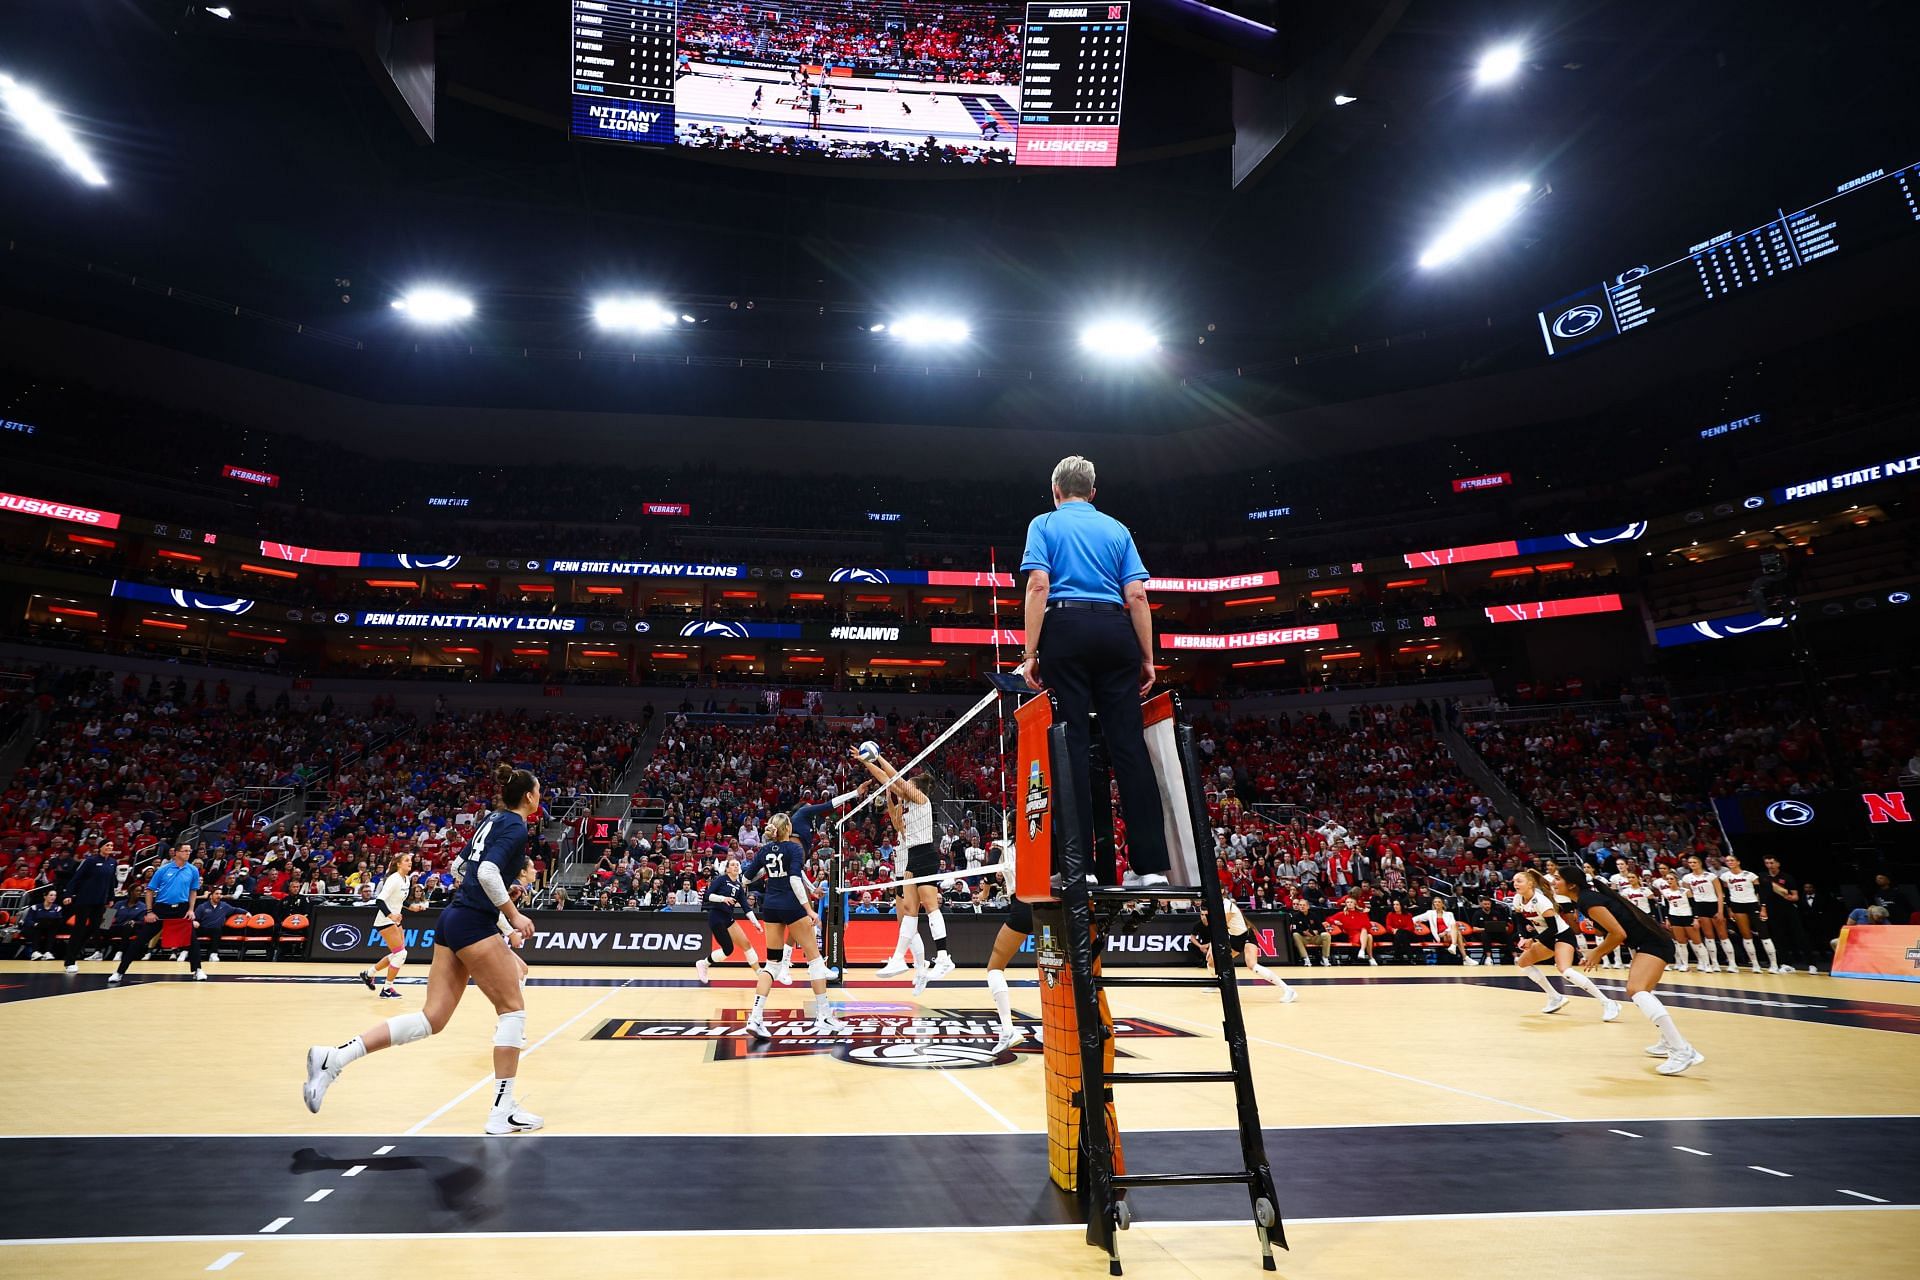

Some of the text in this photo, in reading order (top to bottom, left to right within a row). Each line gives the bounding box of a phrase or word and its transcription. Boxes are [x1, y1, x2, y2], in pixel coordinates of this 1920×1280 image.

[1048, 6, 1122, 19] NEBRASKA N
[590, 106, 660, 123] NITTANY
[600, 119, 650, 133] LIONS
[1027, 140, 1109, 152] HUSKERS
[1837, 168, 1884, 193] NEBRASKA
[1689, 241, 1709, 254] PENN
[1710, 230, 1733, 245] STATE
[1701, 424, 1728, 438] PENN
[1786, 479, 1828, 500] PENN
[1831, 466, 1881, 489] STATE
[1269, 508, 1290, 517] STATE
[553, 561, 738, 577] PENN STATE NITTANY LIONS
[1186, 575, 1264, 590] HUSKERS
[364, 613, 576, 631] PENN STATE NITTANY LIONS
[830, 627, 899, 640] #NCAAWVB
[1174, 628, 1320, 648] NEBRASKA HUSKERS
[1862, 792, 1912, 823] N
[594, 824, 608, 837] N
[468, 821, 494, 862] 14
[765, 854, 788, 877] 21
[367, 929, 418, 947] PN
[503, 932, 607, 949] TANY
[612, 933, 702, 950] LIONS
[1108, 935, 1199, 951] HUSK
